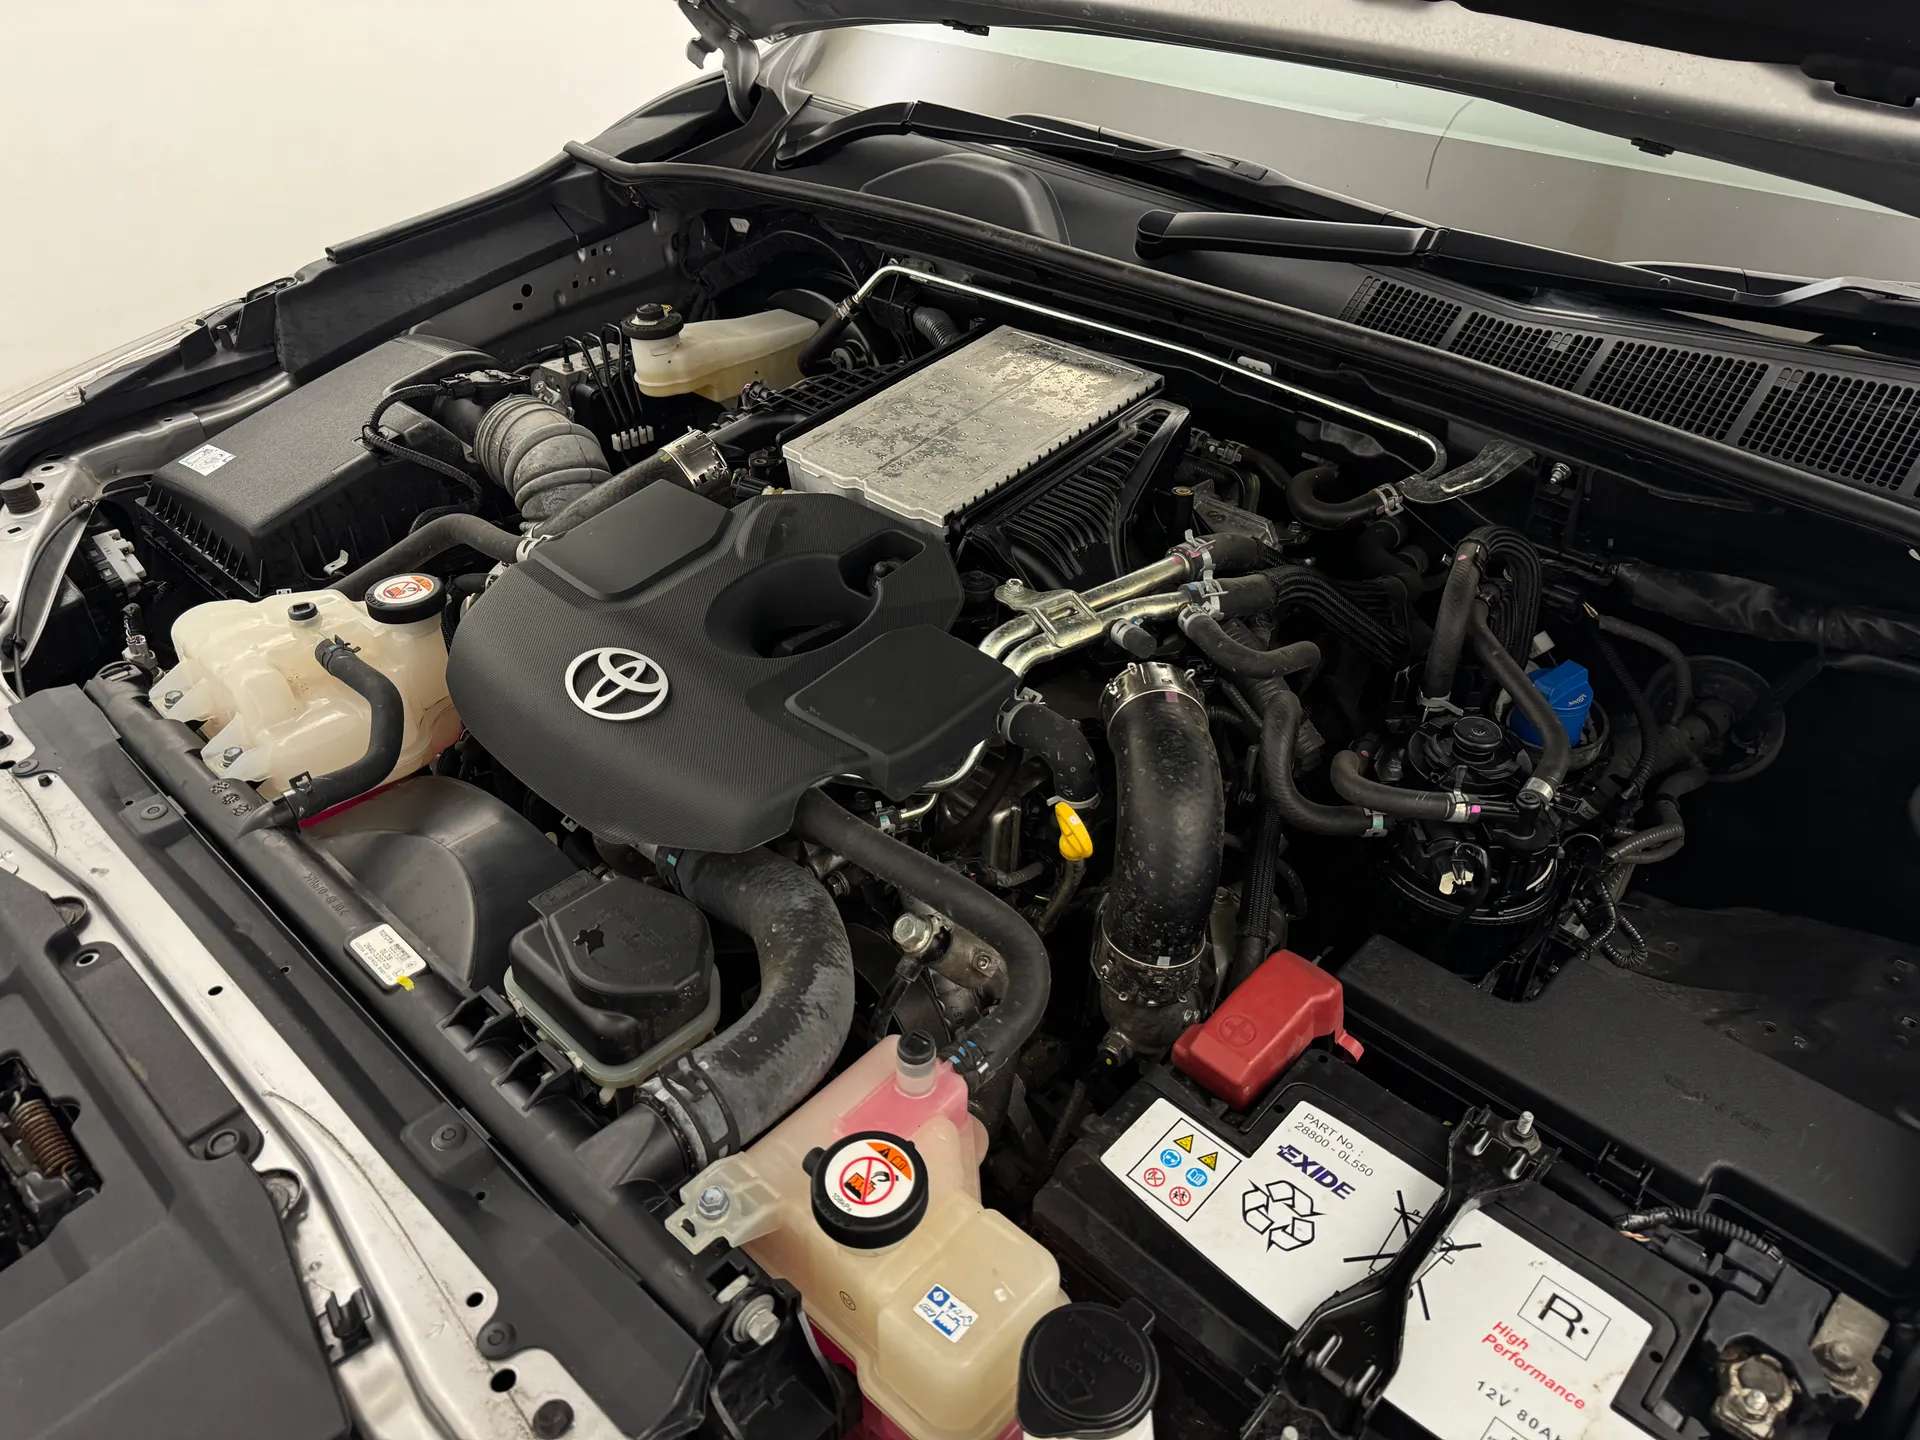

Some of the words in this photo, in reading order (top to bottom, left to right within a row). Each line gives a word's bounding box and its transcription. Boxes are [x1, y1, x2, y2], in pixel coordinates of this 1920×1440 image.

[1294, 1122, 1330, 1148] 28800
[1337, 1150, 1373, 1177] 0L550
[1303, 1113, 1337, 1136] PART
[1336, 1135, 1354, 1152] No.
[1276, 1144, 1356, 1200] EXIDE
[1492, 1321, 1530, 1350] High
[1476, 1380, 1511, 1407] 12V
[1481, 1333, 1586, 1410] Performance
